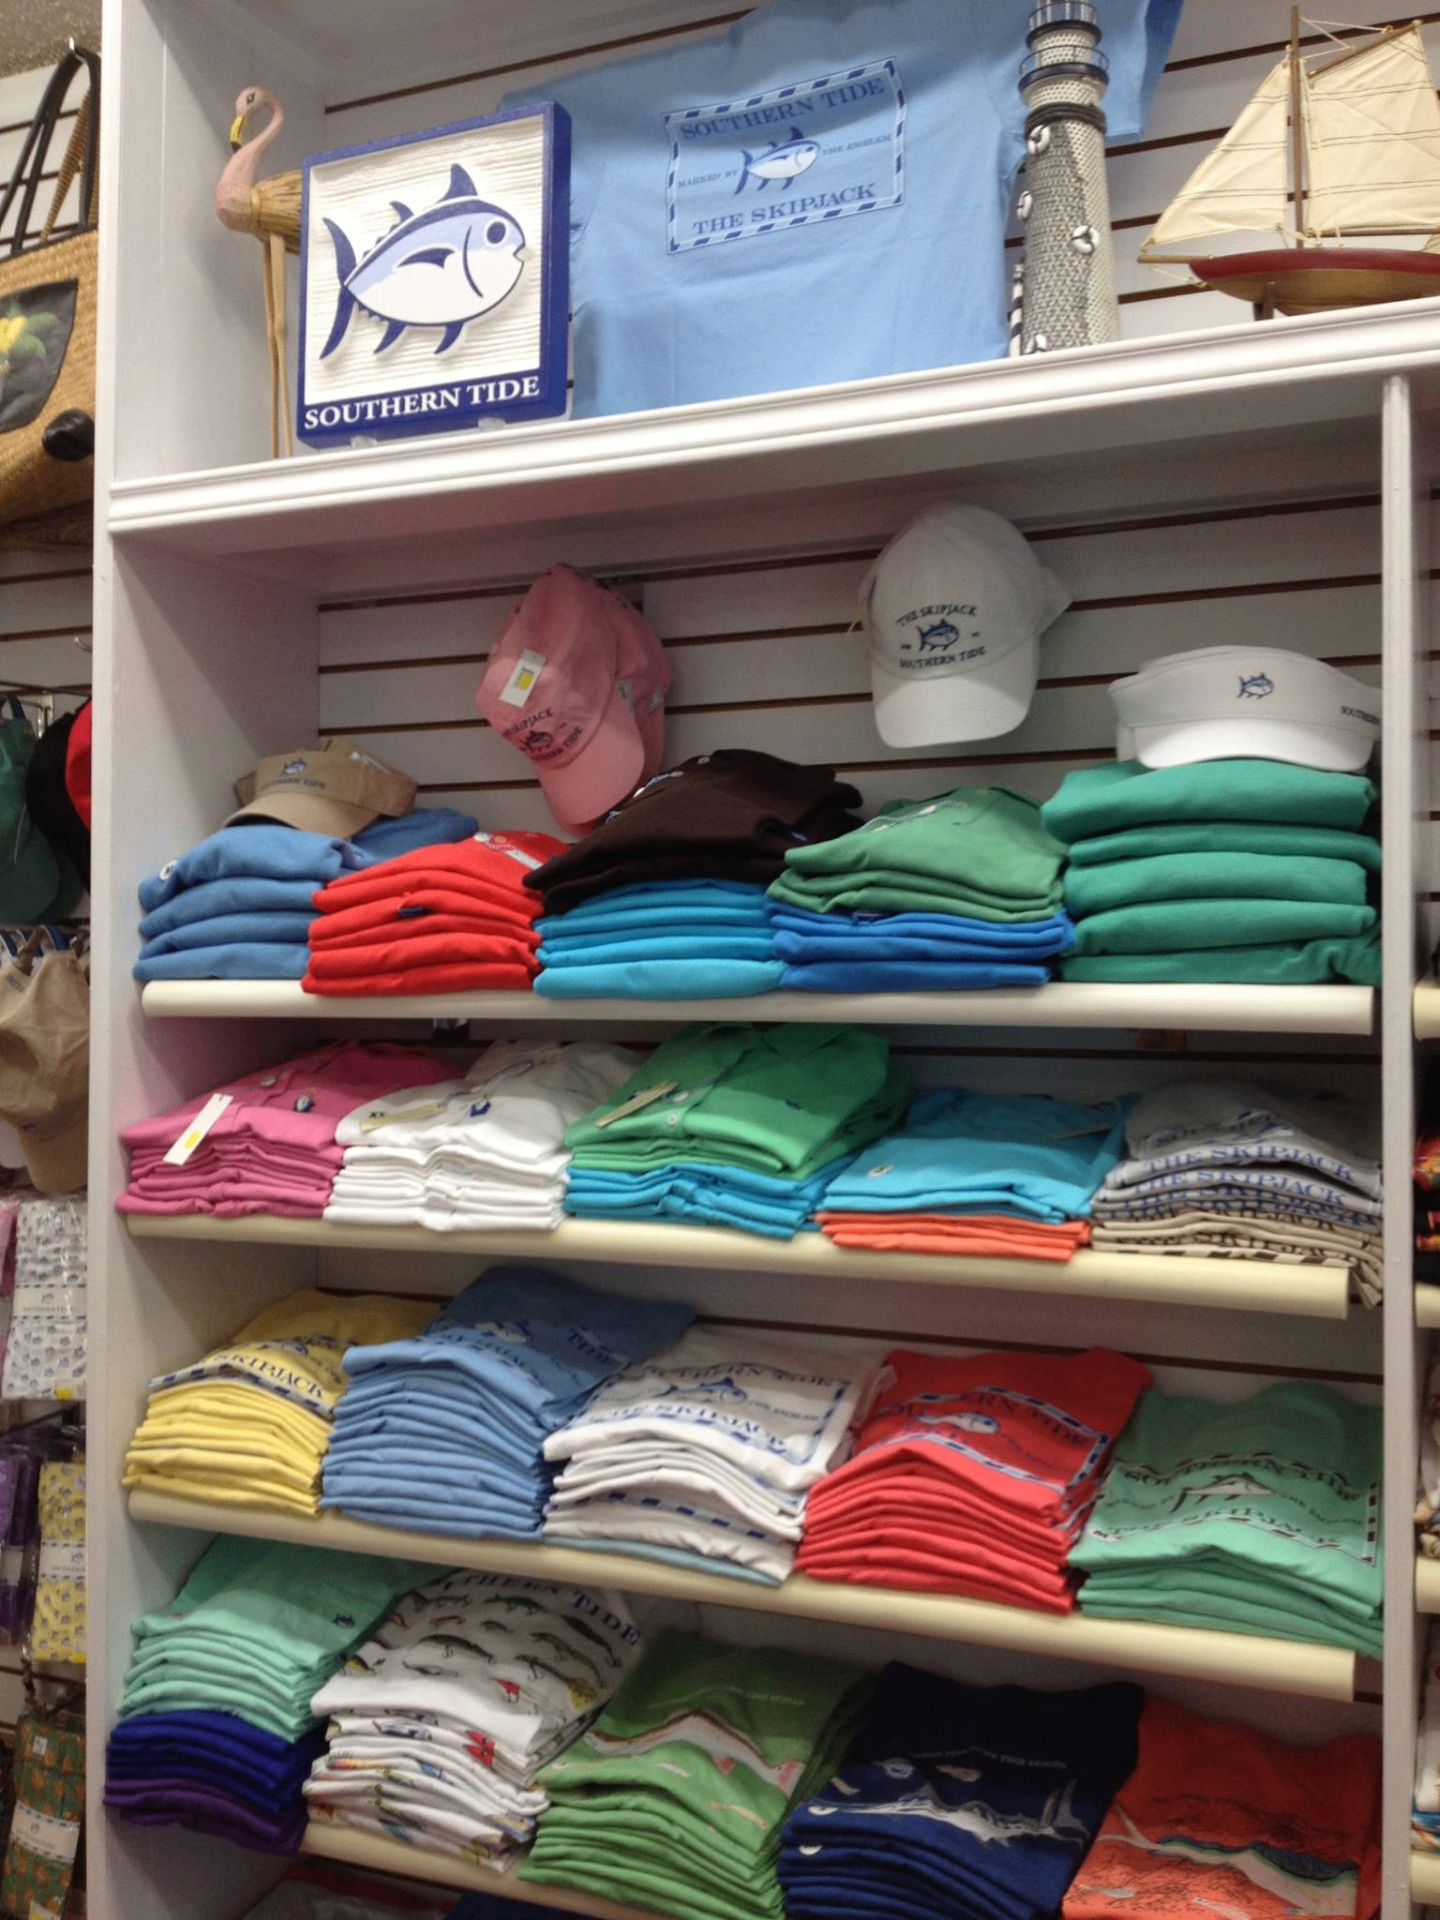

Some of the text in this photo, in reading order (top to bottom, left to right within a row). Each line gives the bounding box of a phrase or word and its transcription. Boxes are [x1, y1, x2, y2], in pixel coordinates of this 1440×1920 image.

[679, 77, 885, 140] SOUTHERN TIDE
[692, 182, 877, 235] THE SKIPJACK
[304, 375, 541, 430] SOUTHERN TIDE
[896, 603, 978, 628] THE SKIPJACK
[959, 646, 987, 662] TIDE
[1148, 1144, 1356, 1183] THE SKIPJACK
[1134, 1170, 1346, 1207] THE SKIPJACK
[214, 1353, 323, 1398] SKIPJACK
[572, 1589, 641, 1647] TIDE
